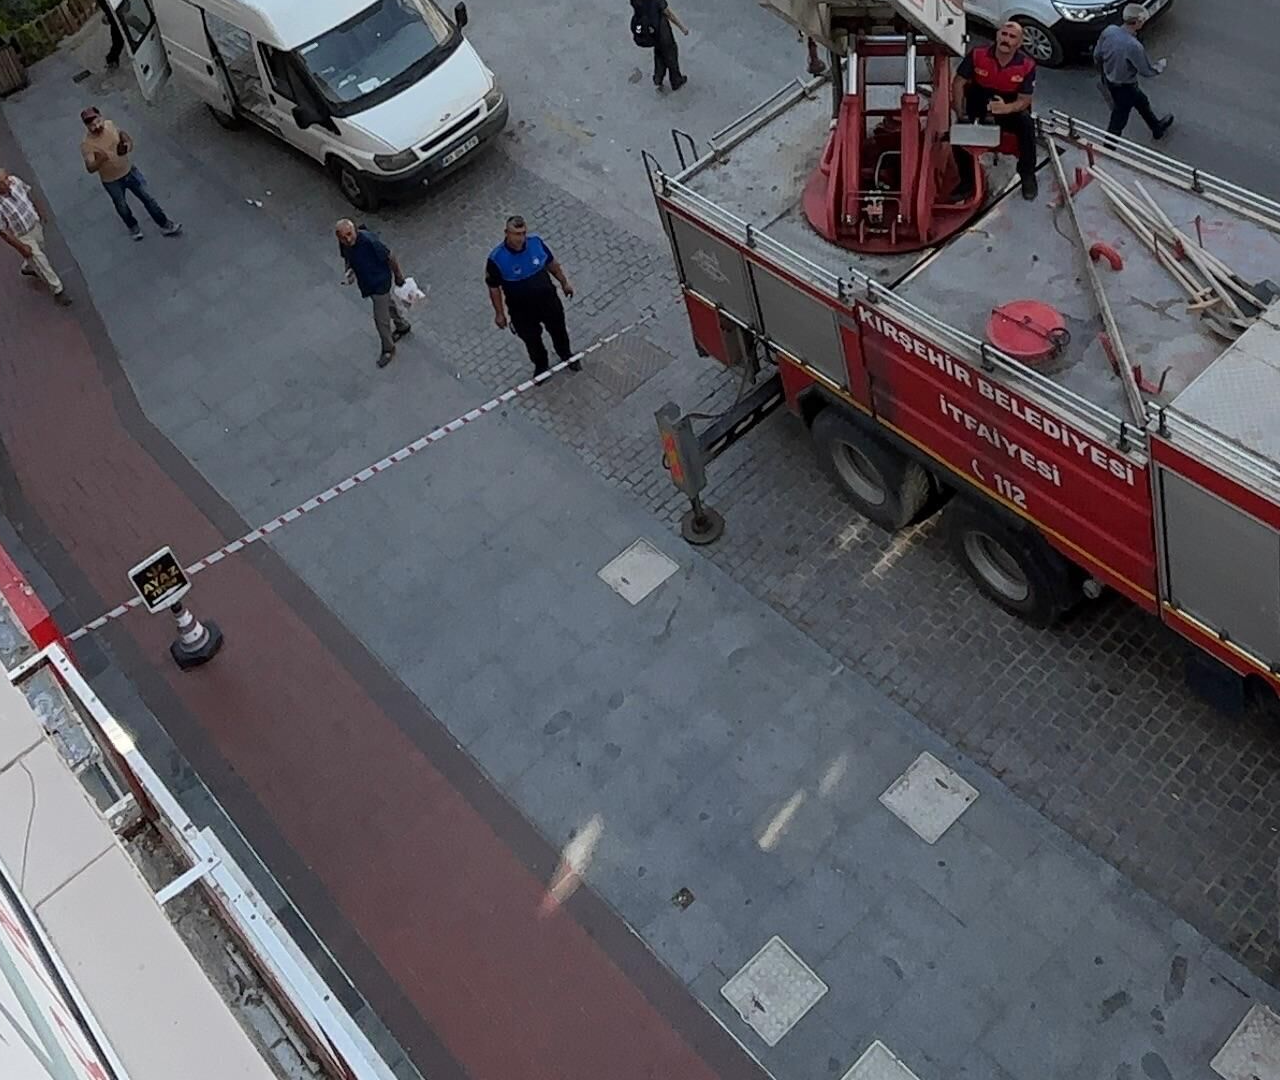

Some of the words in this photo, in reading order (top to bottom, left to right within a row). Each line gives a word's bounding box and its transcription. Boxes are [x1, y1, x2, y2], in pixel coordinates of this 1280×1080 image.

[857, 304, 973, 389] KIRŞEHİR
[977, 378, 1135, 487] BELEDİYESİ
[939, 394, 1062, 487] İTFAİYESİ
[993, 473, 1028, 511] 112
